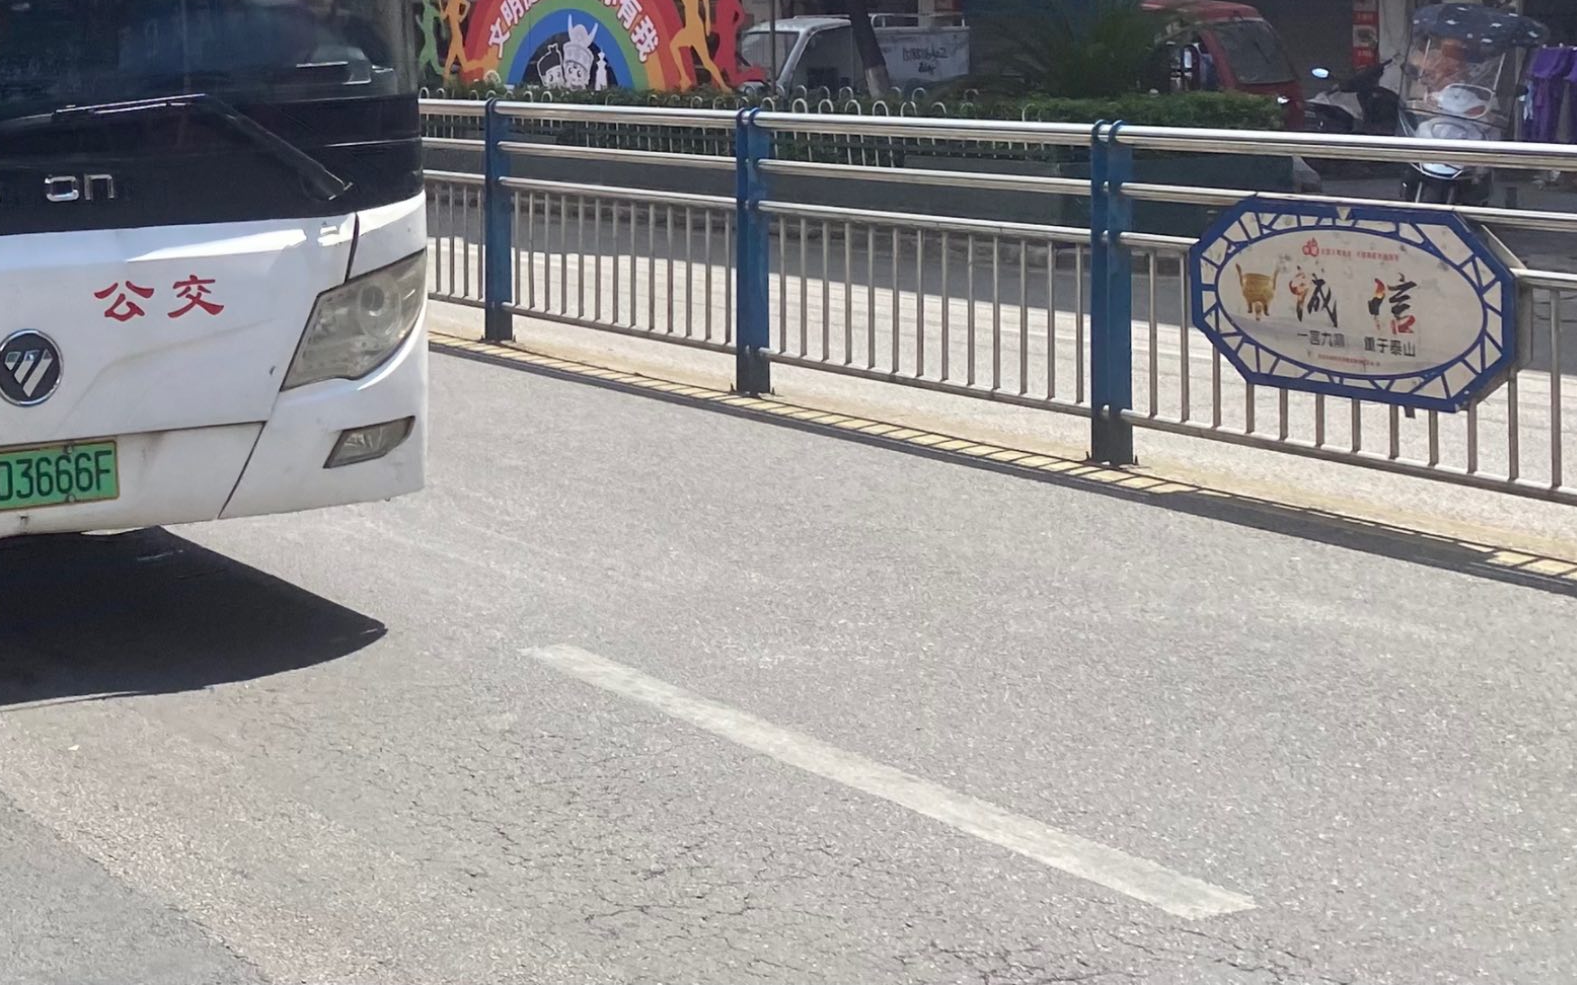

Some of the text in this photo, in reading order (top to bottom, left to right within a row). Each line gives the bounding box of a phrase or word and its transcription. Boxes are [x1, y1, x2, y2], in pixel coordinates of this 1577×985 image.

[93, 274, 225, 322] 公交
[1363, 336, 1417, 358] 重于泰山
